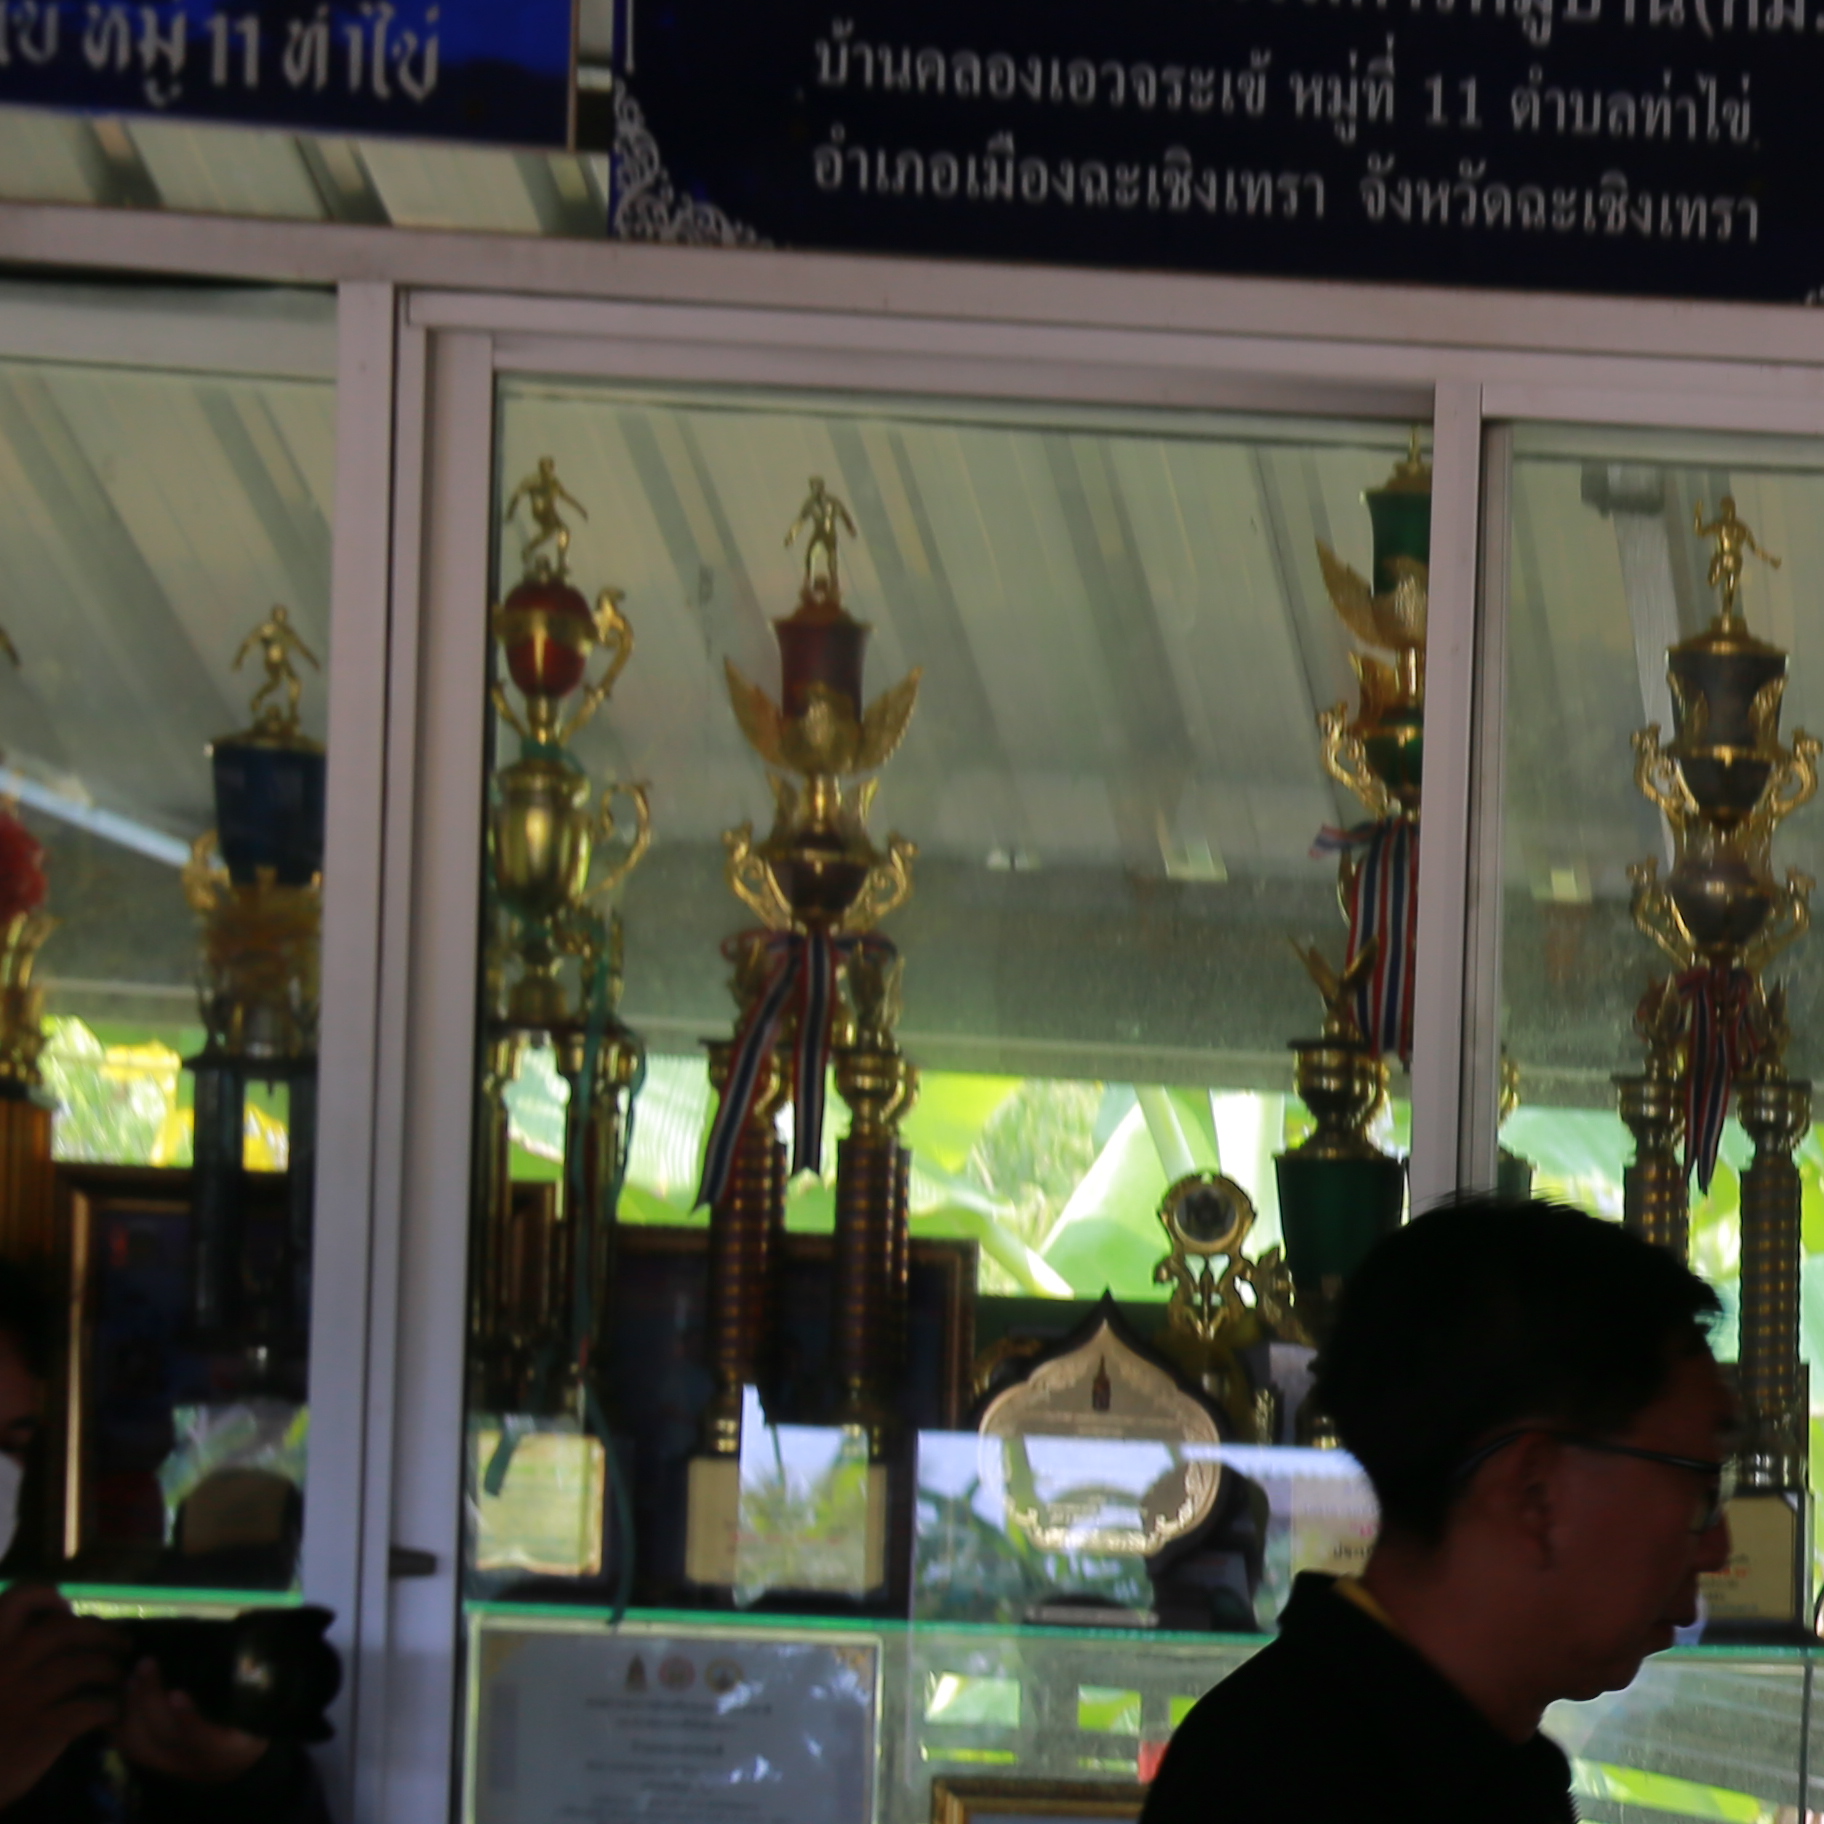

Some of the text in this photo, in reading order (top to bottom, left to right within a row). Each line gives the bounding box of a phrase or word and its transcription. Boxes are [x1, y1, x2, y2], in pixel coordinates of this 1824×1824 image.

[205, 12, 261, 87] 11
[282, 0, 440, 101] ท่าไข่
[814, 20, 1272, 116] บ้านคลองเอวจระเข้
[1288, 33, 1396, 144] หมู่ที่
[1425, 74, 1481, 128] 11
[1509, 67, 1752, 142] ตำบลท่าไข่
[814, 126, 1759, 242] อำเภอเมืองฉะเชิงเทรา จังหวัดฉะเชิงเทรา
